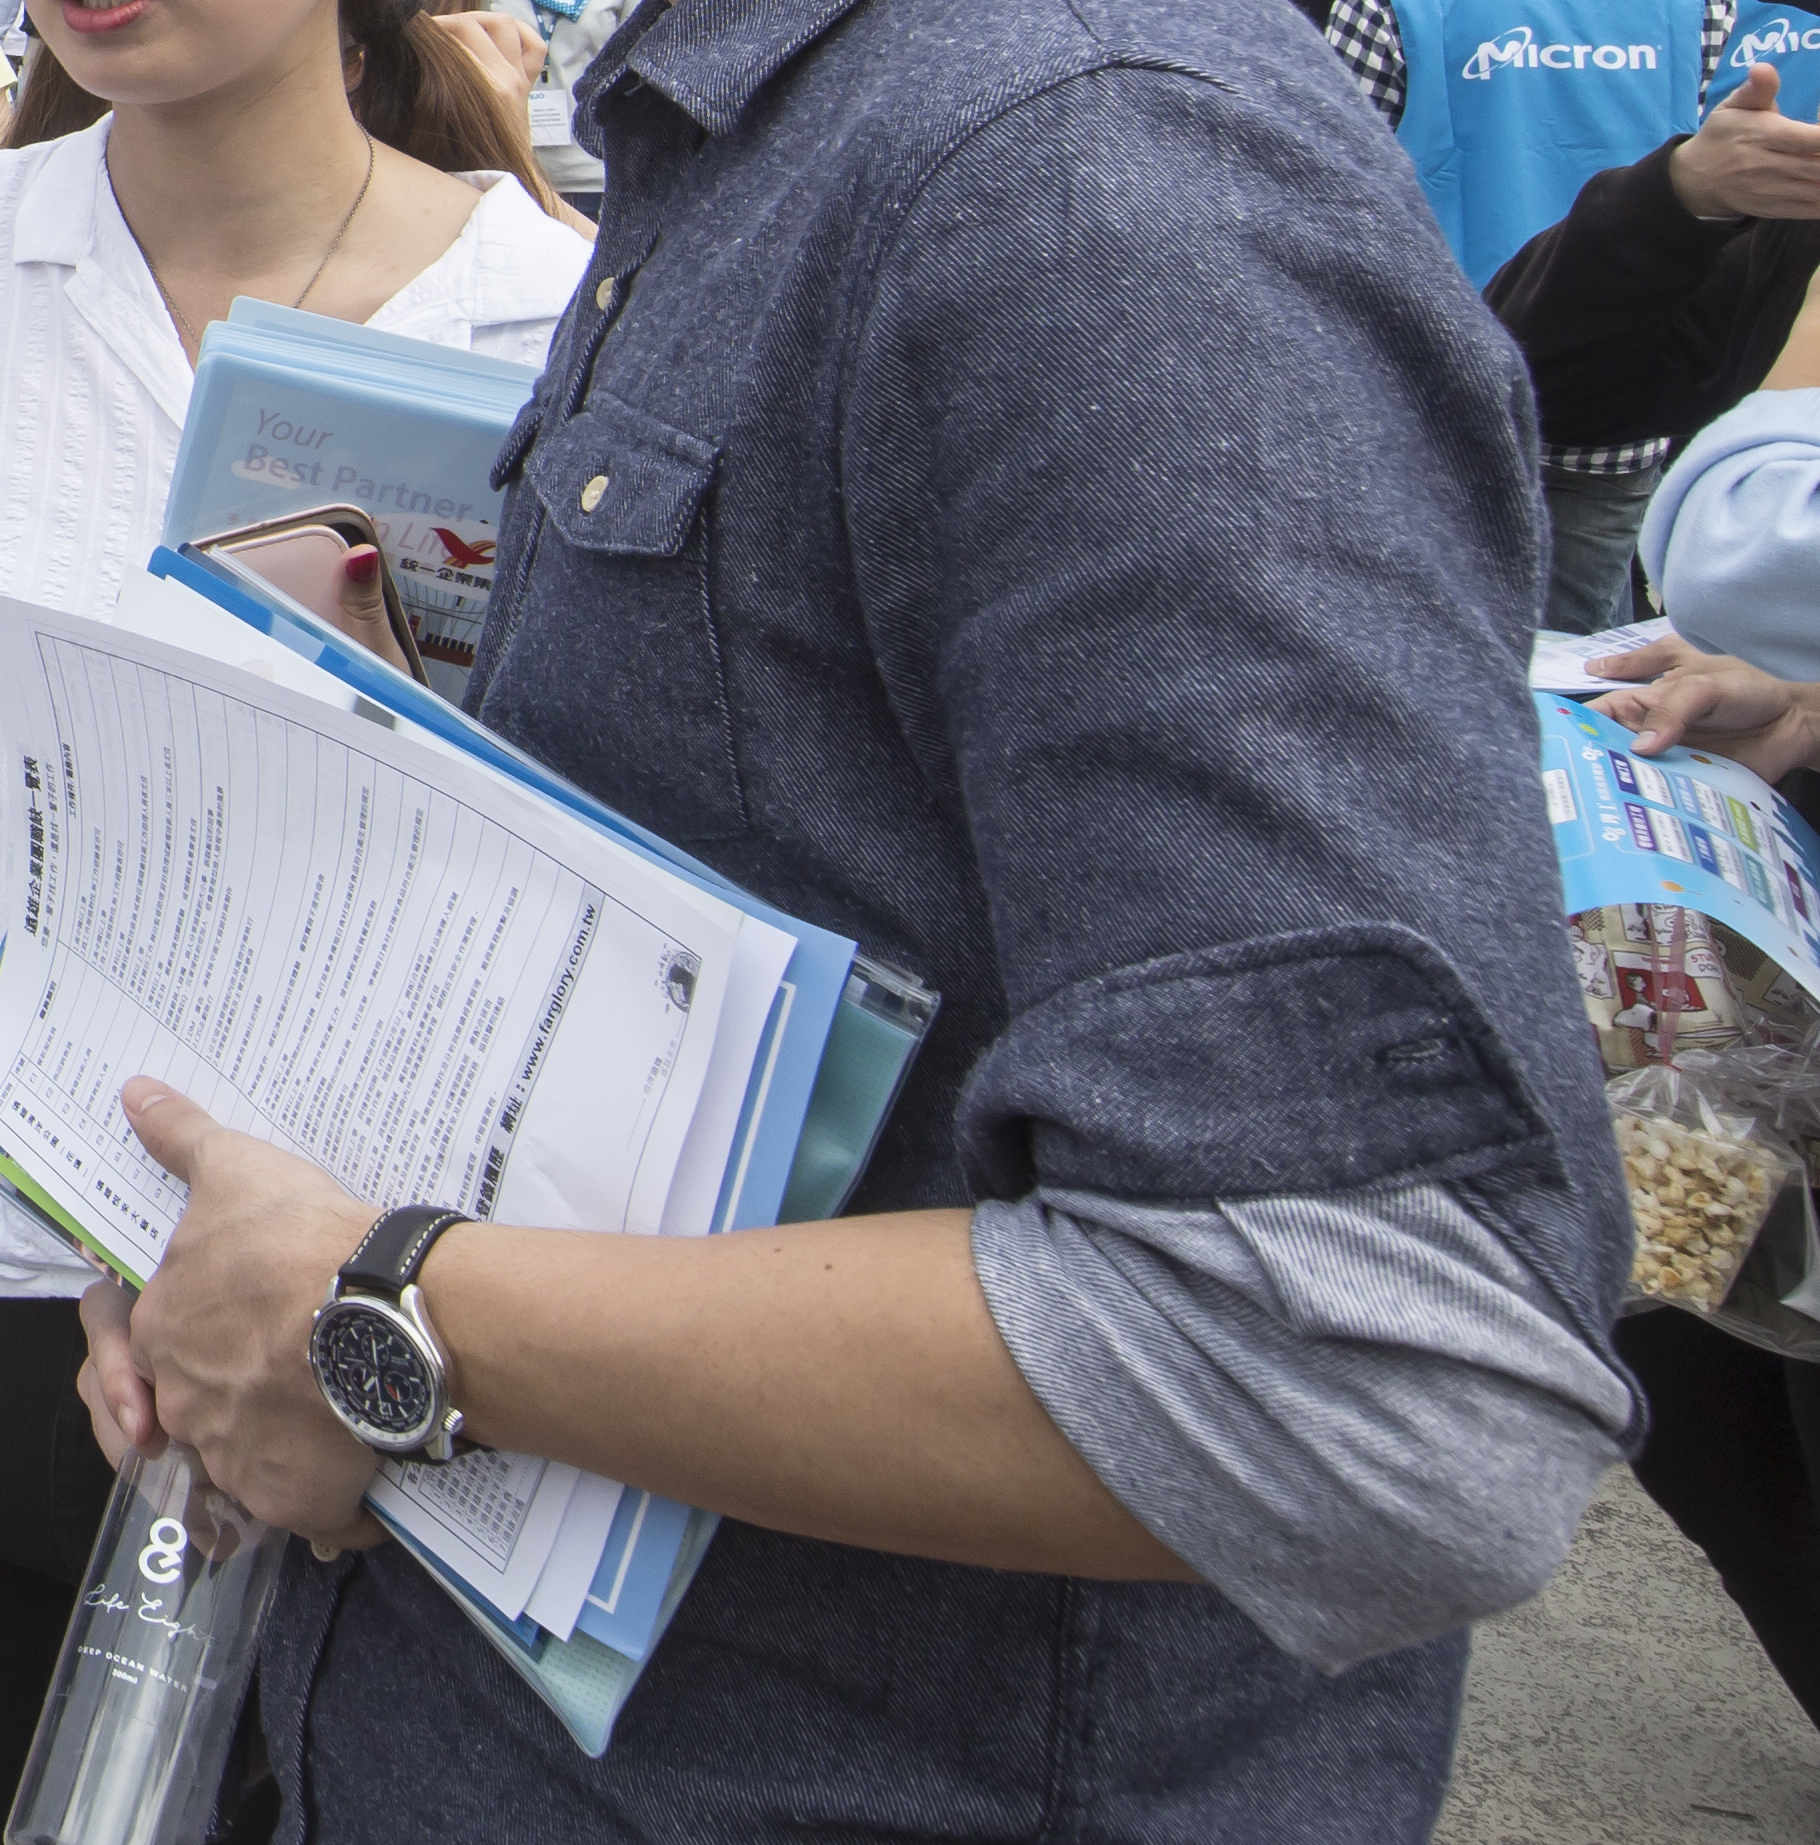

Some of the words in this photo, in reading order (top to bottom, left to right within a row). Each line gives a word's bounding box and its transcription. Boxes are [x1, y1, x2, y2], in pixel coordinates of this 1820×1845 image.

[1461, 25, 1657, 81] Micron
[257, 407, 334, 451] Your
[243, 443, 325, 487] Best
[331, 463, 473, 524] Partner
[77, 1644, 103, 1656] DEEP
[105, 1651, 146, 1673] OCEAN
[148, 1666, 189, 1694] WATER
